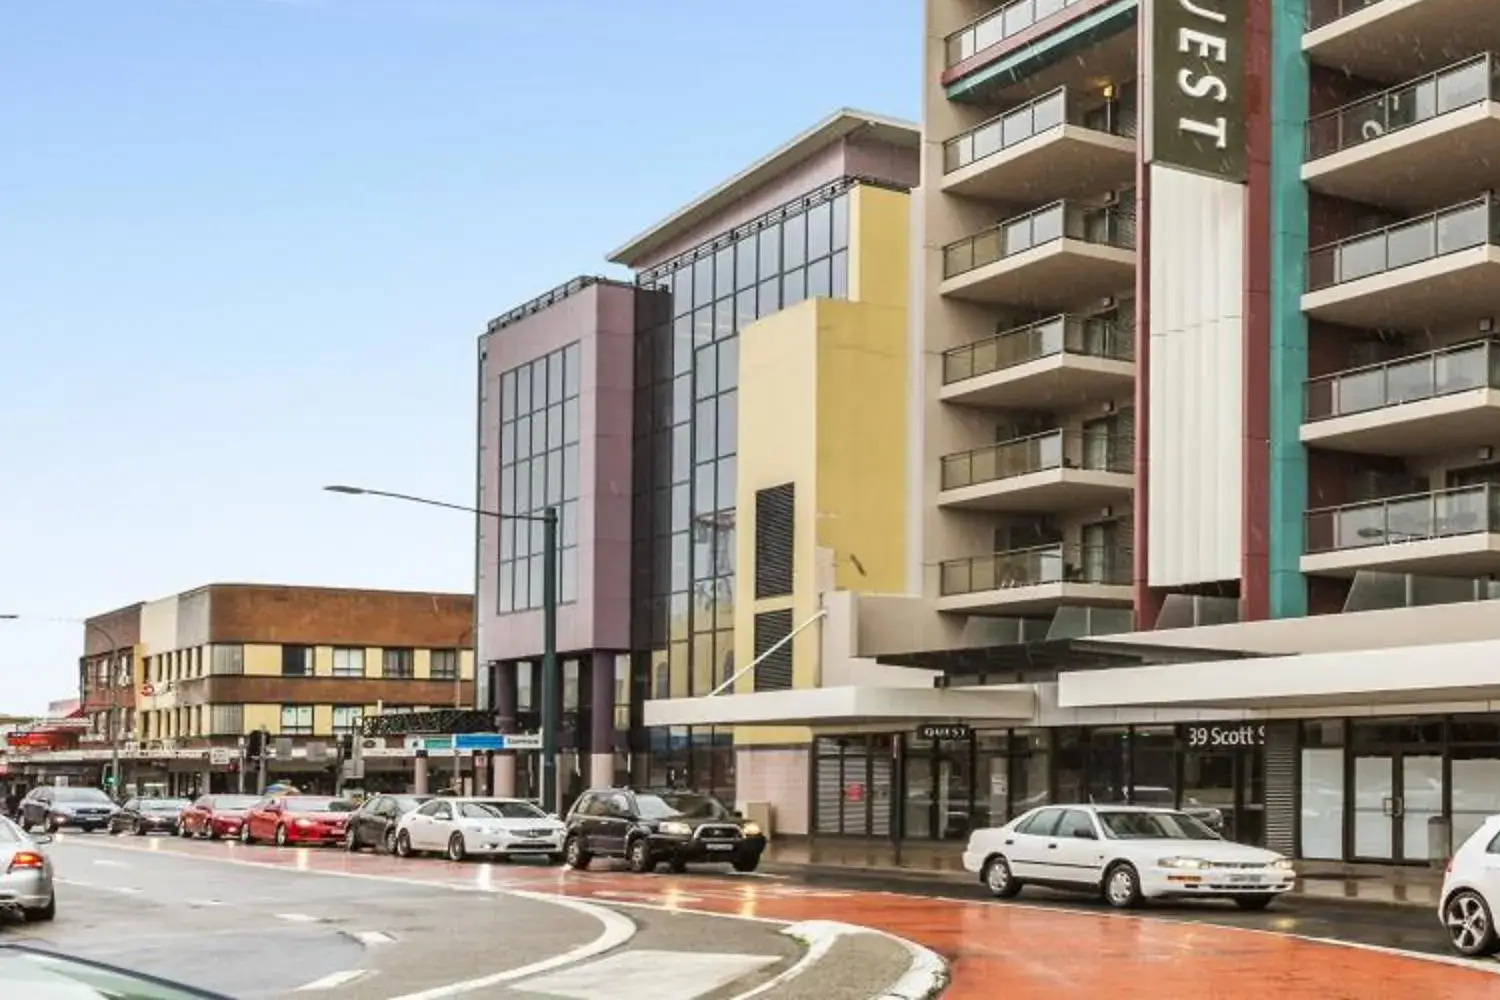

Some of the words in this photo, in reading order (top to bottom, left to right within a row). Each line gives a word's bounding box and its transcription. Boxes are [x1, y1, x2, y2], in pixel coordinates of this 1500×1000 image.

[924, 727, 966, 738] QUEST
[1189, 727, 1209, 746] 39
[1211, 725, 1255, 746] Scott
